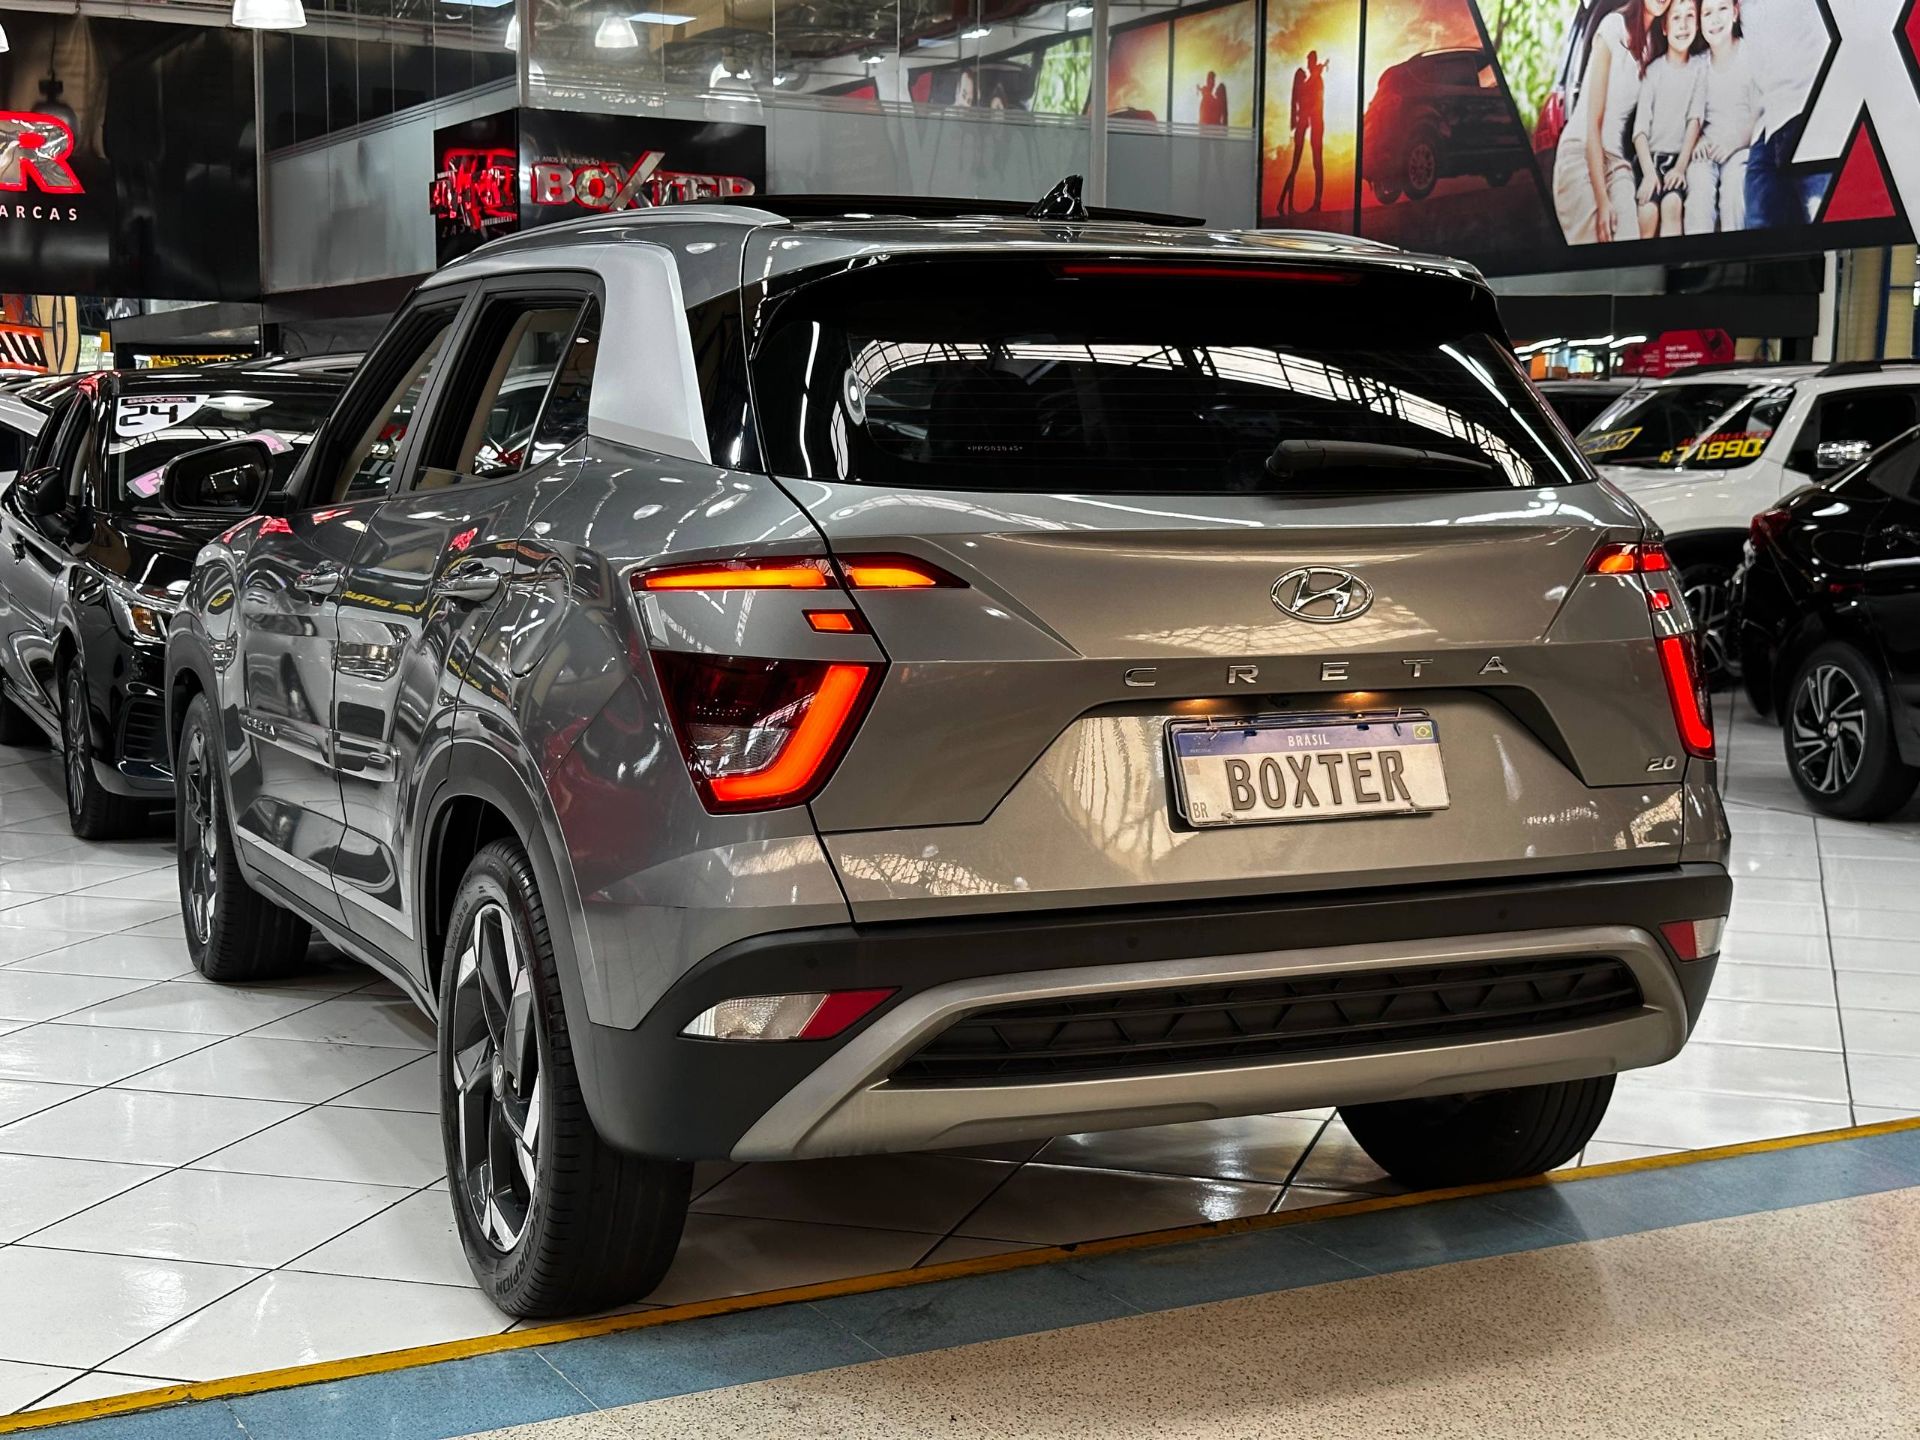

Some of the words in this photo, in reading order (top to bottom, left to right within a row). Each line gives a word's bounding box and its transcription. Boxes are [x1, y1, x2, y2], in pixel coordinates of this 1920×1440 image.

[119, 404, 178, 426] 24
[1123, 655, 1509, 688] CRETA
[1287, 733, 1330, 747] BRASIL
[1225, 750, 1412, 810] BOXTER
[1191, 801, 1209, 819] BR
[495, 1196, 541, 1296] SCORPION
